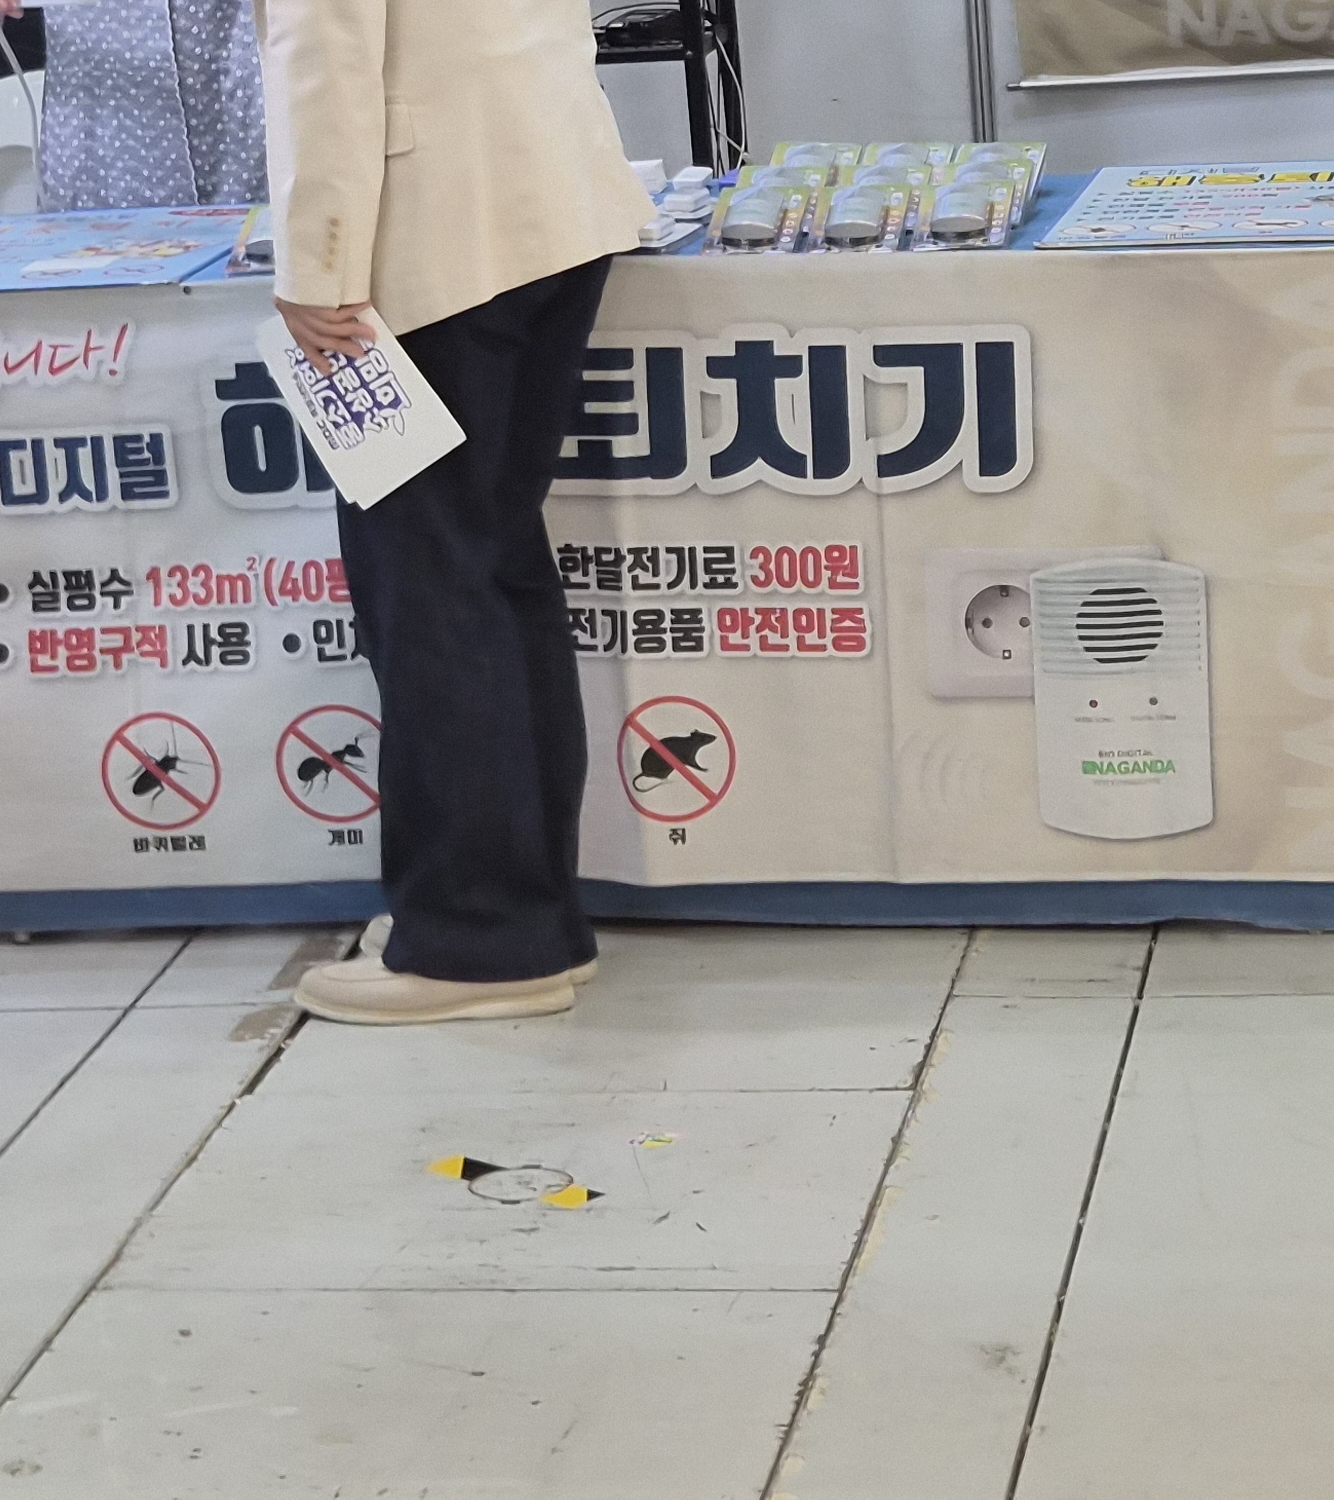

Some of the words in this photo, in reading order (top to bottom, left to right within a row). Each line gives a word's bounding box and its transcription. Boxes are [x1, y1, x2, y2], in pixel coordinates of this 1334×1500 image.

[27, 568, 134, 612] 실평수
[556, 544, 739, 592] 한달전기료
[750, 544, 859, 590] 300원
[27, 624, 168, 673] 반영구적
[182, 621, 251, 666] 사용
[568, 607, 706, 654] 전기용품
[717, 607, 866, 653] 안전인증
[668, 828, 687, 845] 쥐
